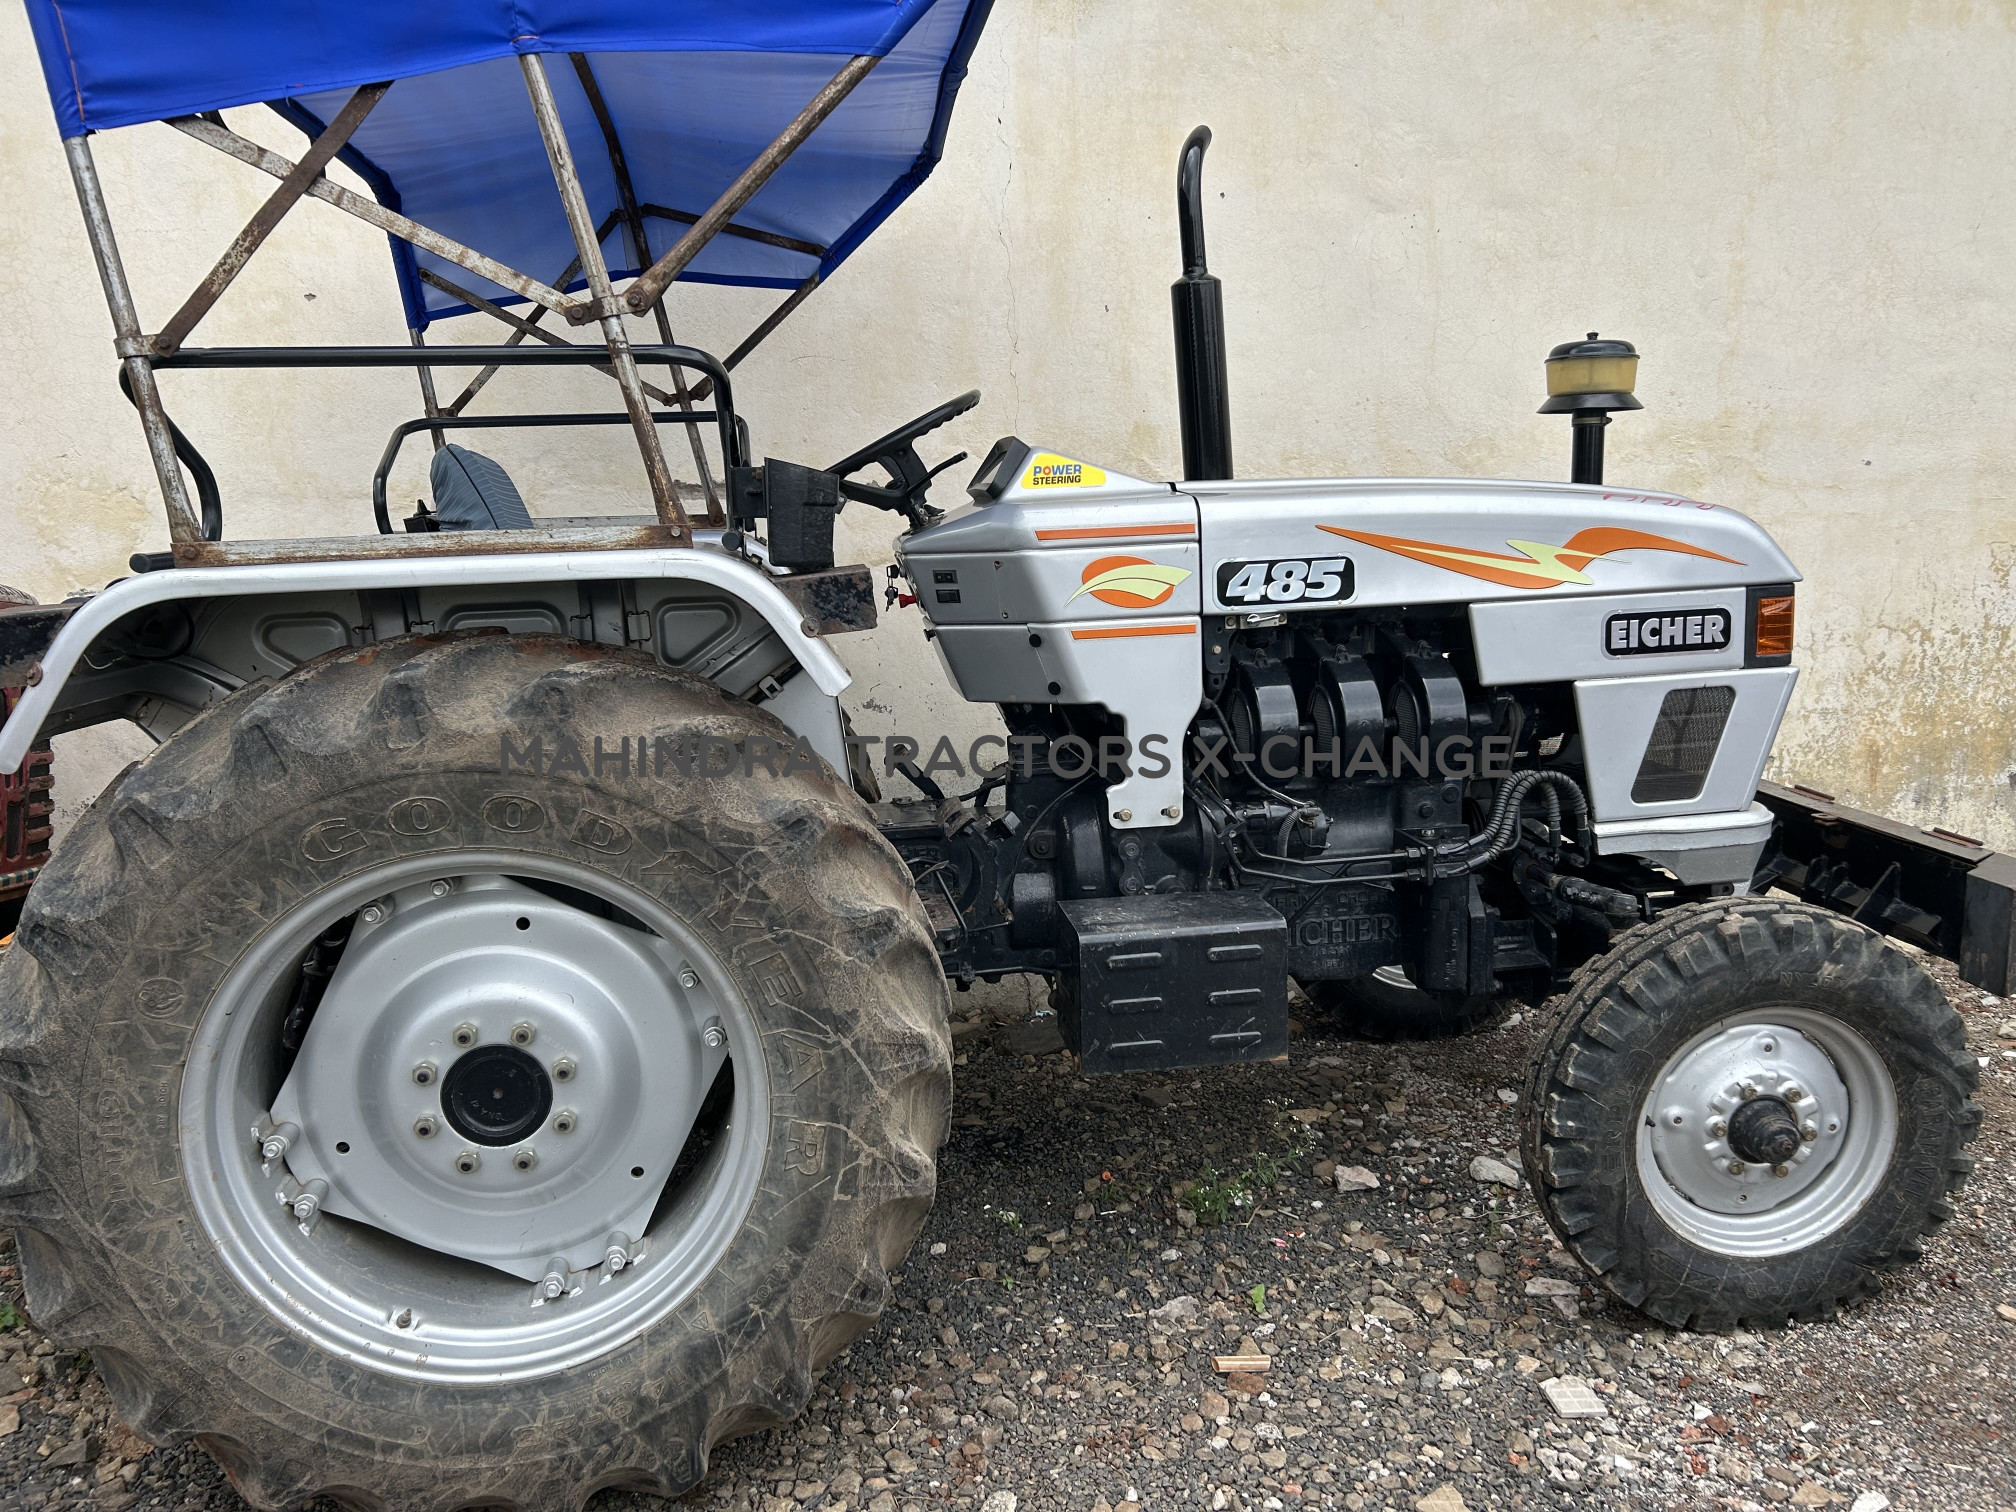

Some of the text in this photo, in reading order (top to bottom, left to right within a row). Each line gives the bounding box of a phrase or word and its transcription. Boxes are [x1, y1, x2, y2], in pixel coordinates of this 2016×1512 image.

[1033, 464, 1082, 476] POWER
[1033, 474, 1082, 485] STEERING
[1225, 560, 1347, 602] 485
[1610, 615, 1725, 649] EICHER
[1288, 913, 1400, 948] ICHER
